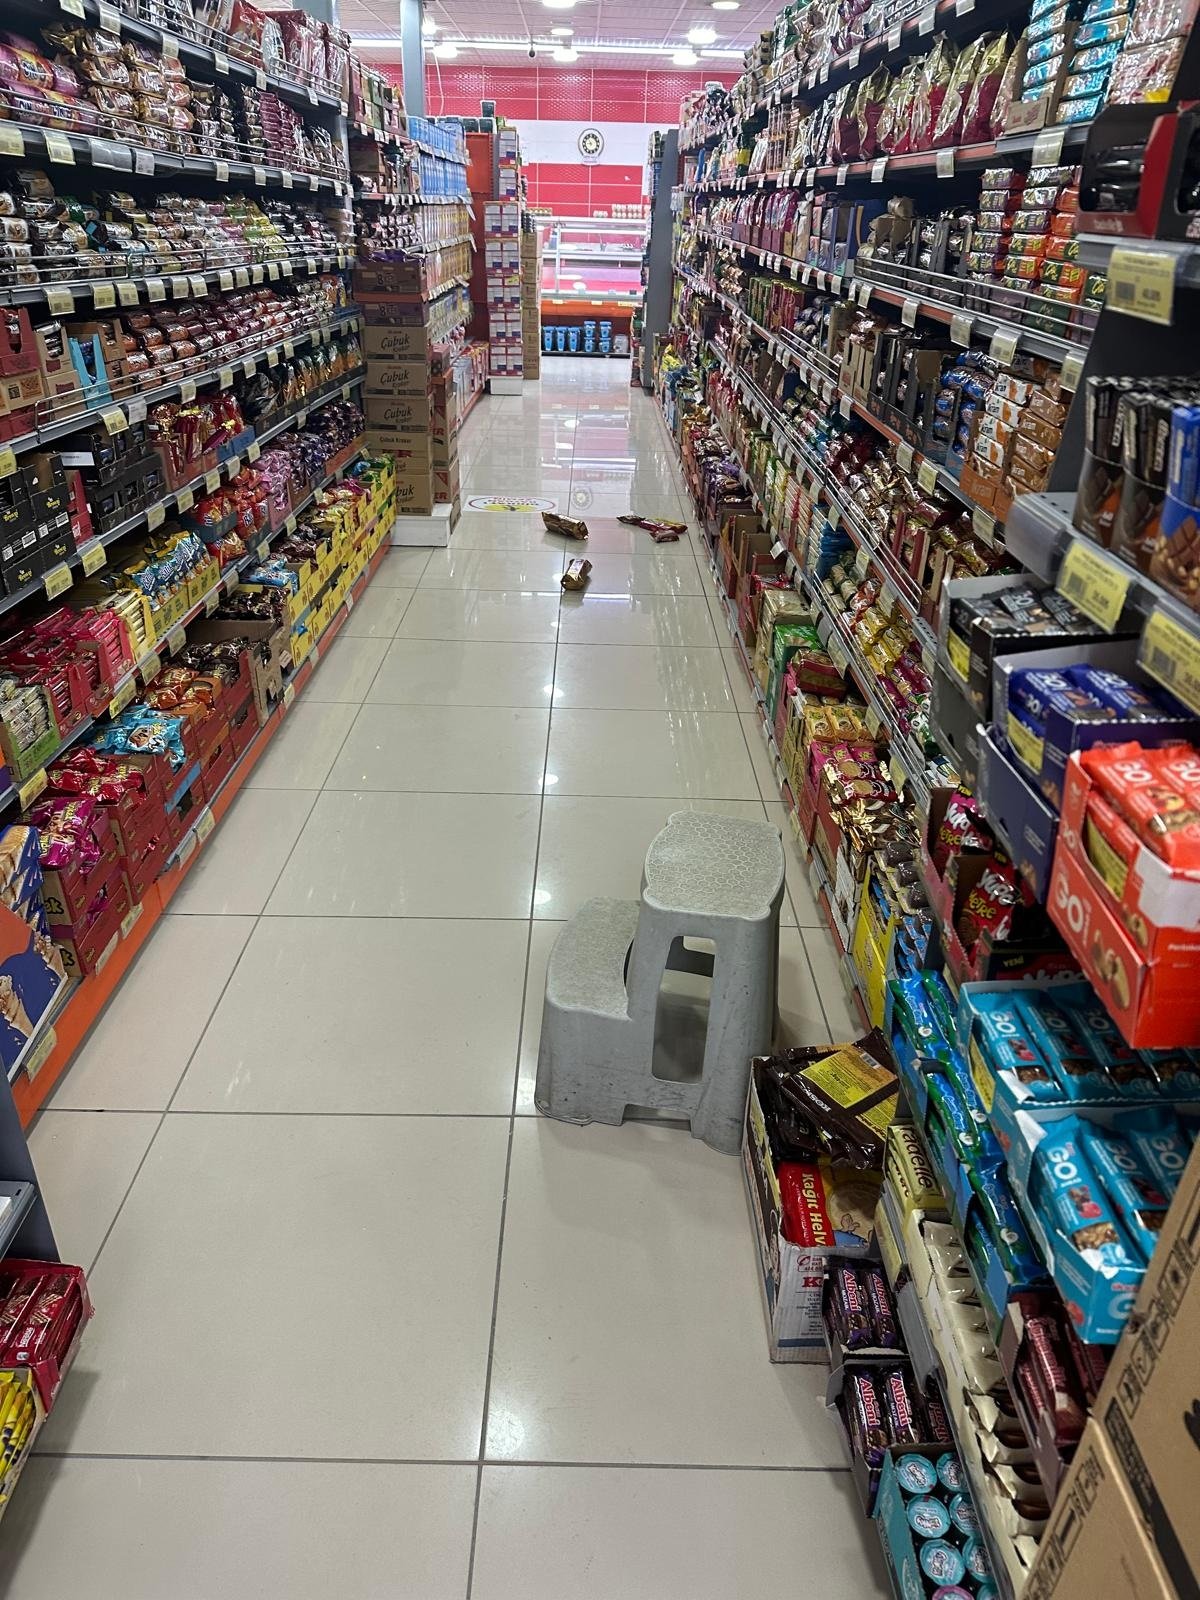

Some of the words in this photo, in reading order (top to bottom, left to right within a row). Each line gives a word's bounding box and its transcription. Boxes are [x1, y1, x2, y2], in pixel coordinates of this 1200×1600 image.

[843, 1269, 862, 1312] Albeni
[872, 1272, 891, 1316] Albeni
[859, 1377, 881, 1427] Albeni
[890, 1377, 912, 1427] Albeni
